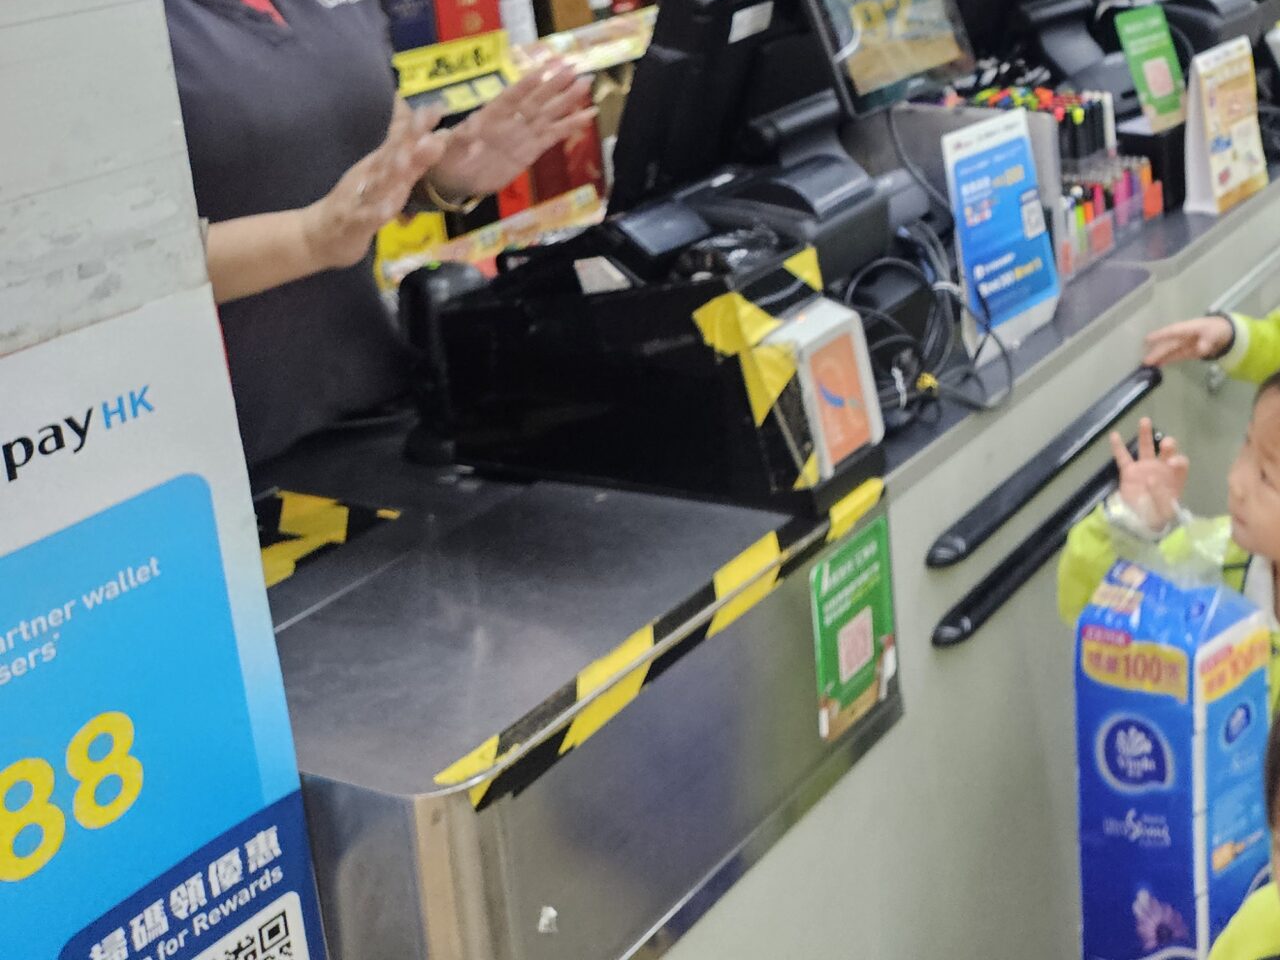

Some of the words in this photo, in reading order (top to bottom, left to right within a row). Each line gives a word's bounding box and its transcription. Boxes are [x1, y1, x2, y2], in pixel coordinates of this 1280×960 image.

[82, 556, 161, 610] wallet
[0, 711, 144, 882] 88
[156, 928, 189, 960] for
[191, 865, 284, 937] Rewards
